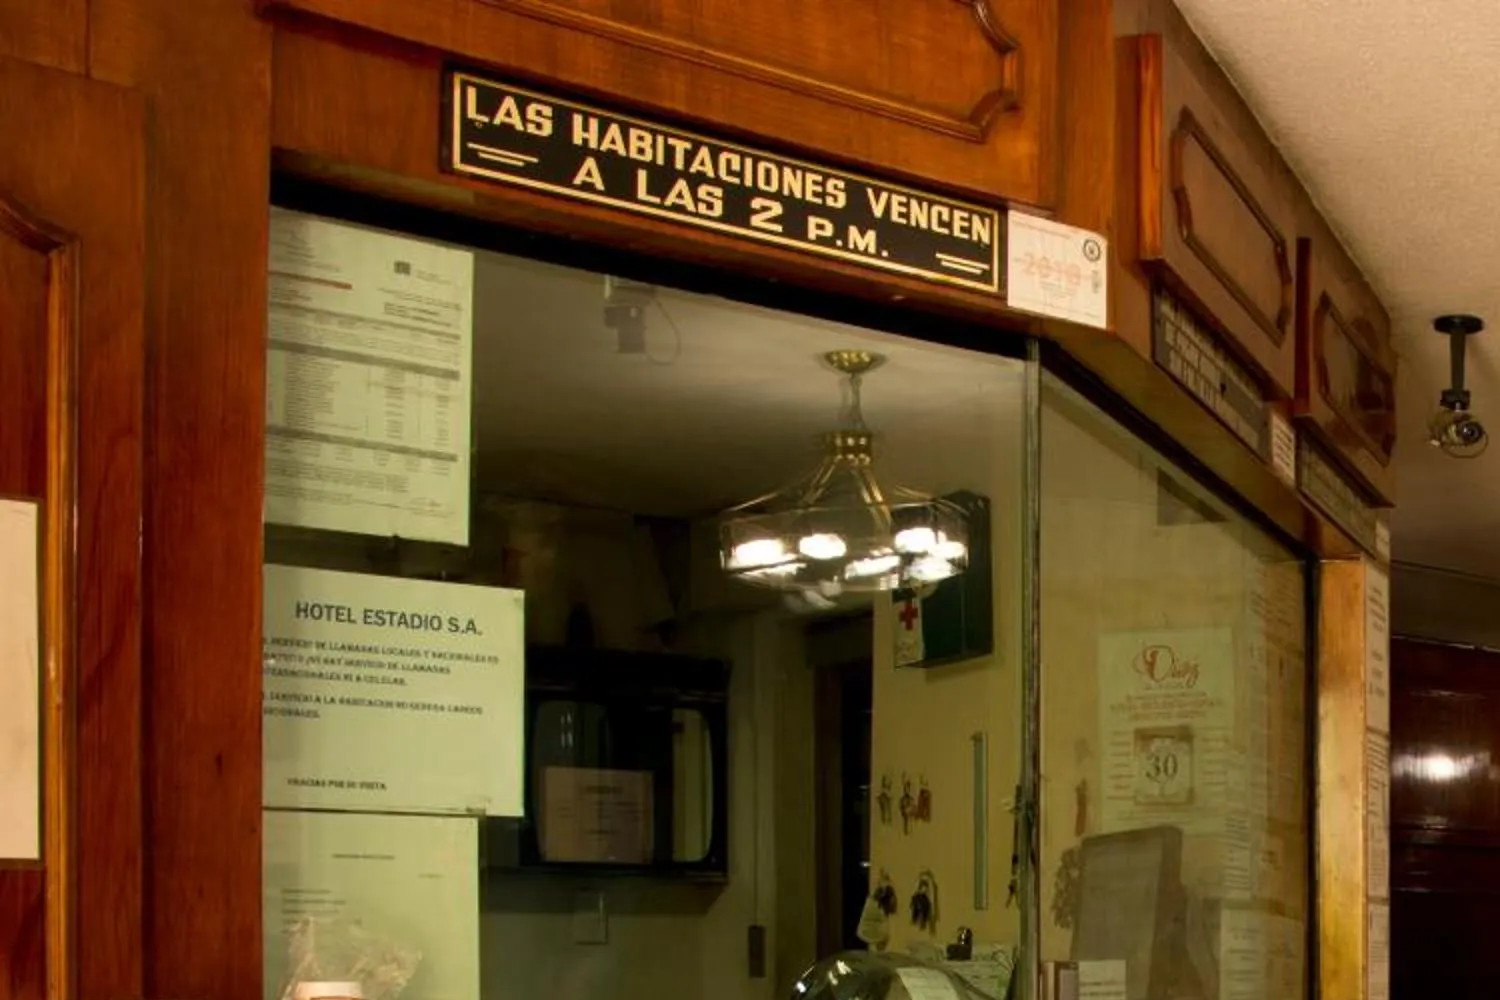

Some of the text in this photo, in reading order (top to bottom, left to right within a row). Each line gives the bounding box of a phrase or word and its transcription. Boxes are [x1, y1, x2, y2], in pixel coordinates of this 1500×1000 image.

[466, 84, 991, 246] LAS HABITACIONES VENCEN
[572, 156, 890, 259] A LAS 2 P.M.
[295, 602, 483, 636] HOTEL ESTADIO S.A.
